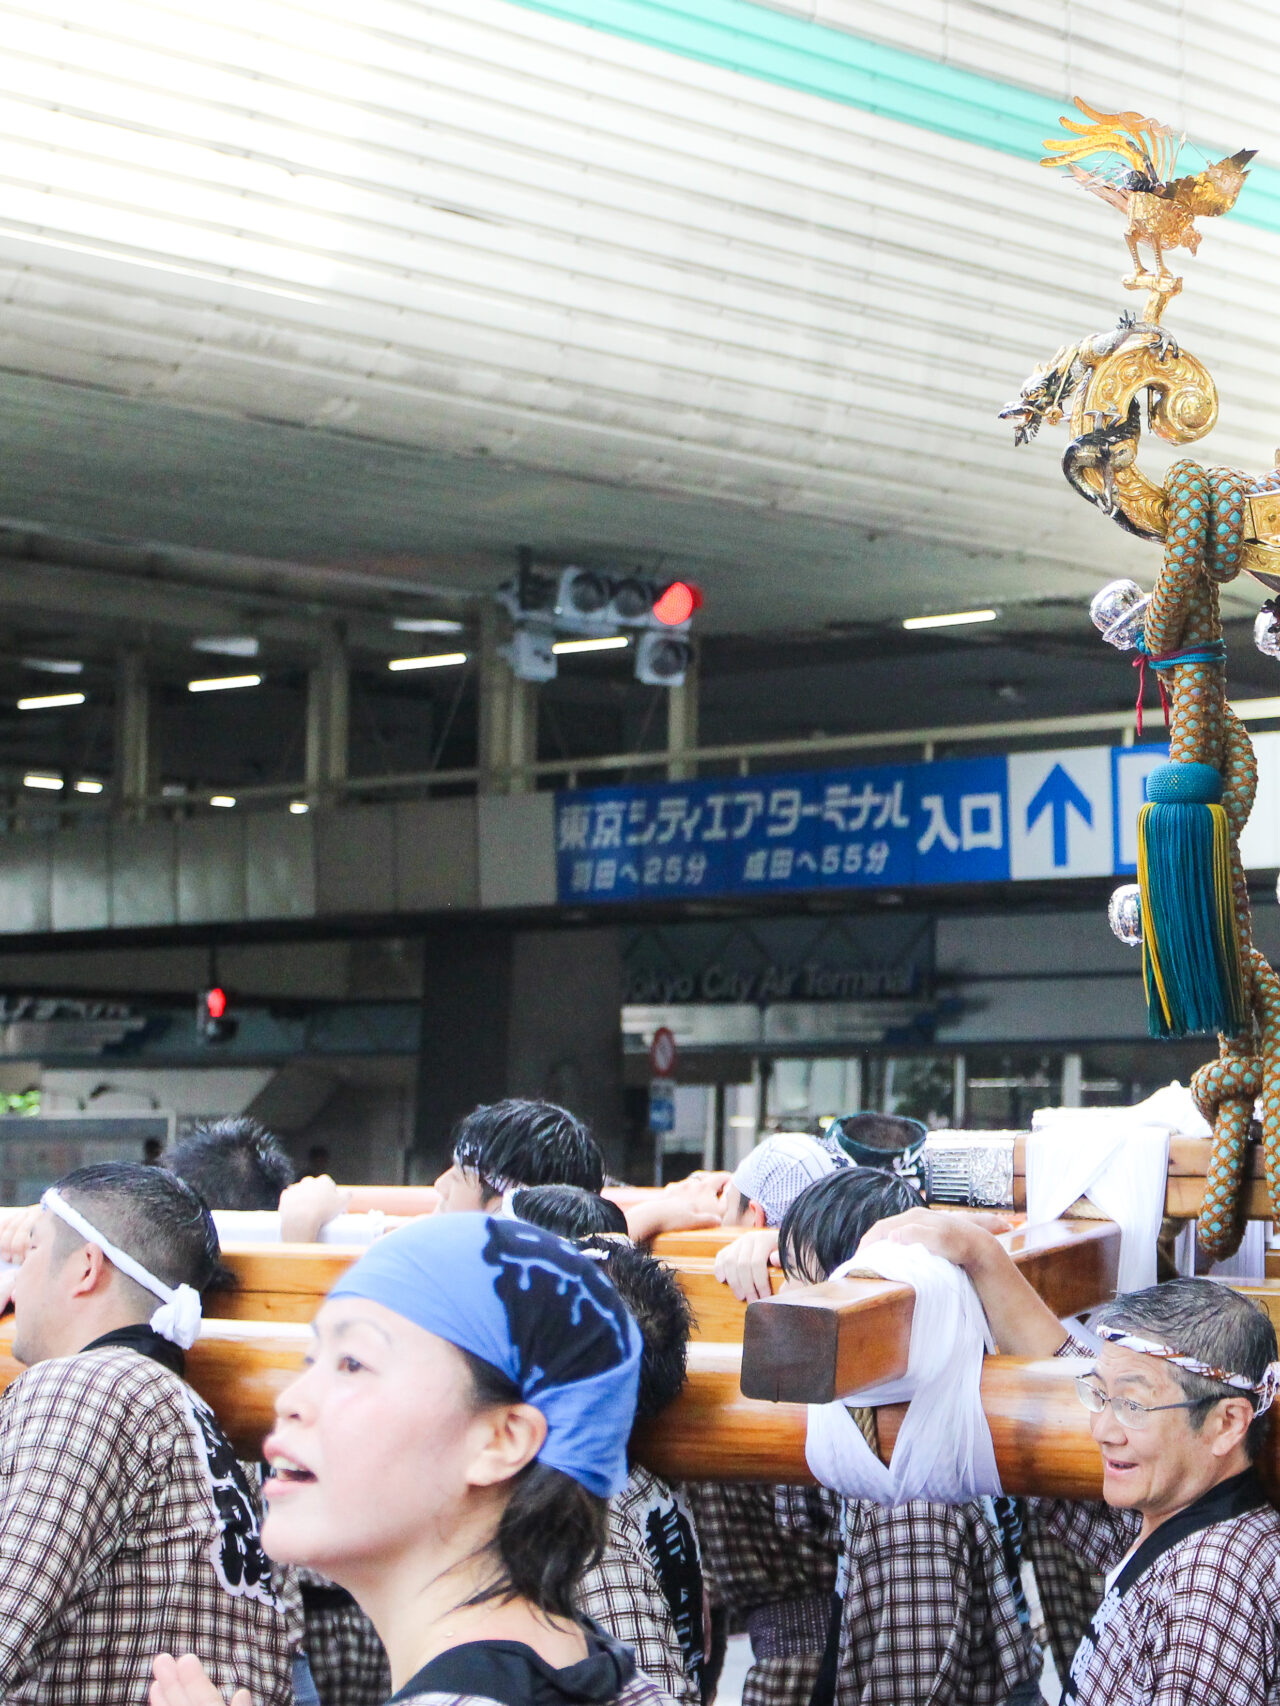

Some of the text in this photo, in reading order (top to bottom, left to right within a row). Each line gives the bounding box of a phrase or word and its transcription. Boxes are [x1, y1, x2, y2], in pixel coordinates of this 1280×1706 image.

[559, 781, 1003, 854] 東京シティエアターミナル 入口
